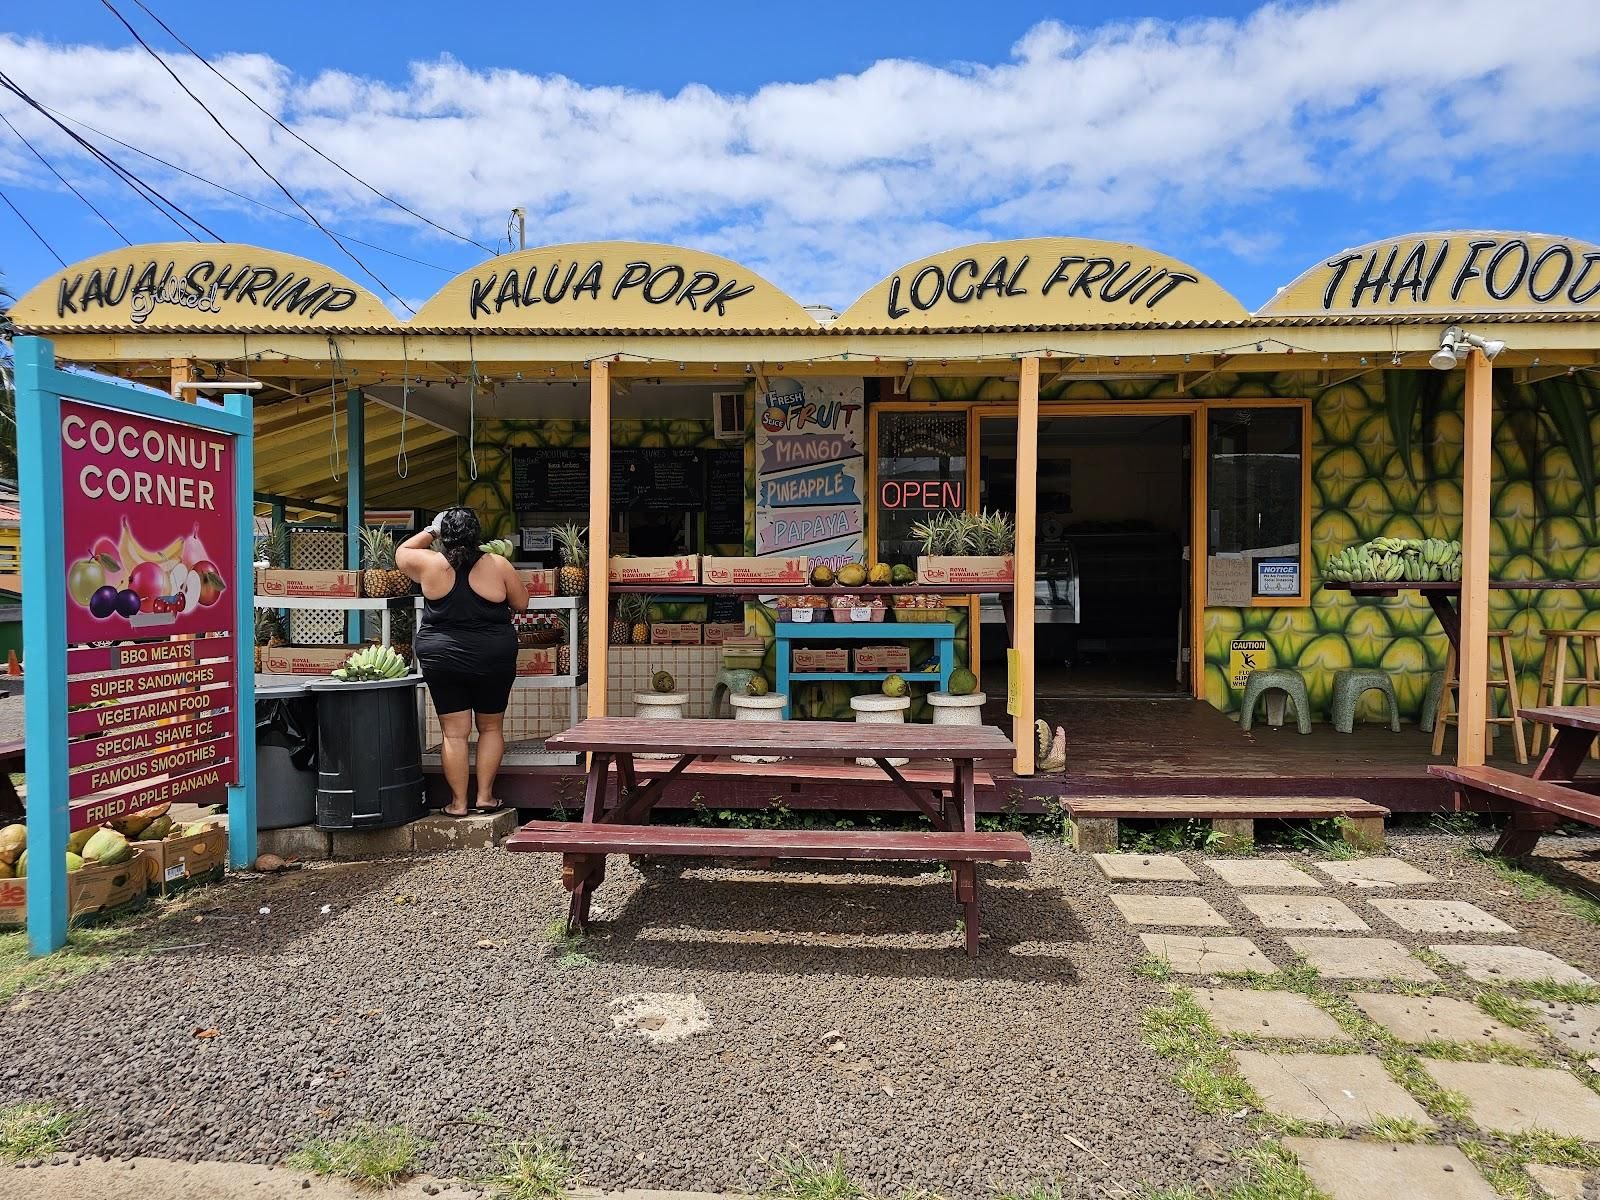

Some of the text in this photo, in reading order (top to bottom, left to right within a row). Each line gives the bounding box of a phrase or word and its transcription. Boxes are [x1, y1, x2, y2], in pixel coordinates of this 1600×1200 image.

[57, 261, 358, 319] KAUAI SHRIMP
[470, 260, 756, 320] KALUA PORK
[888, 255, 1199, 320] LOCAL FRUIT
[1322, 239, 1600, 310] THAI FOOD
[769, 390, 803, 407] FRESH
[785, 401, 862, 431] FRUIT
[62, 415, 225, 472] COCONUT
[775, 439, 842, 463] MANGO
[79, 465, 215, 511] CORNER
[767, 472, 844, 504] PINEAPPLE
[882, 481, 961, 508] OPEN
[773, 511, 849, 545] PAPAYA
[808, 554, 853, 574] OCONUT
[121, 644, 191, 665] BBQ MEATS
[1232, 641, 1265, 650] CAUTION
[90, 668, 214, 698] SUPER SANDWICHES
[97, 694, 210, 727] VEGETARIAN FOOD
[96, 720, 213, 758] SPECIAL SHAVE ICE
[92, 744, 216, 789] FAMOUS SMOOTHIES
[87, 770, 219, 824] FRIED APPLE BANANA
[0, 882, 24, 902] le
